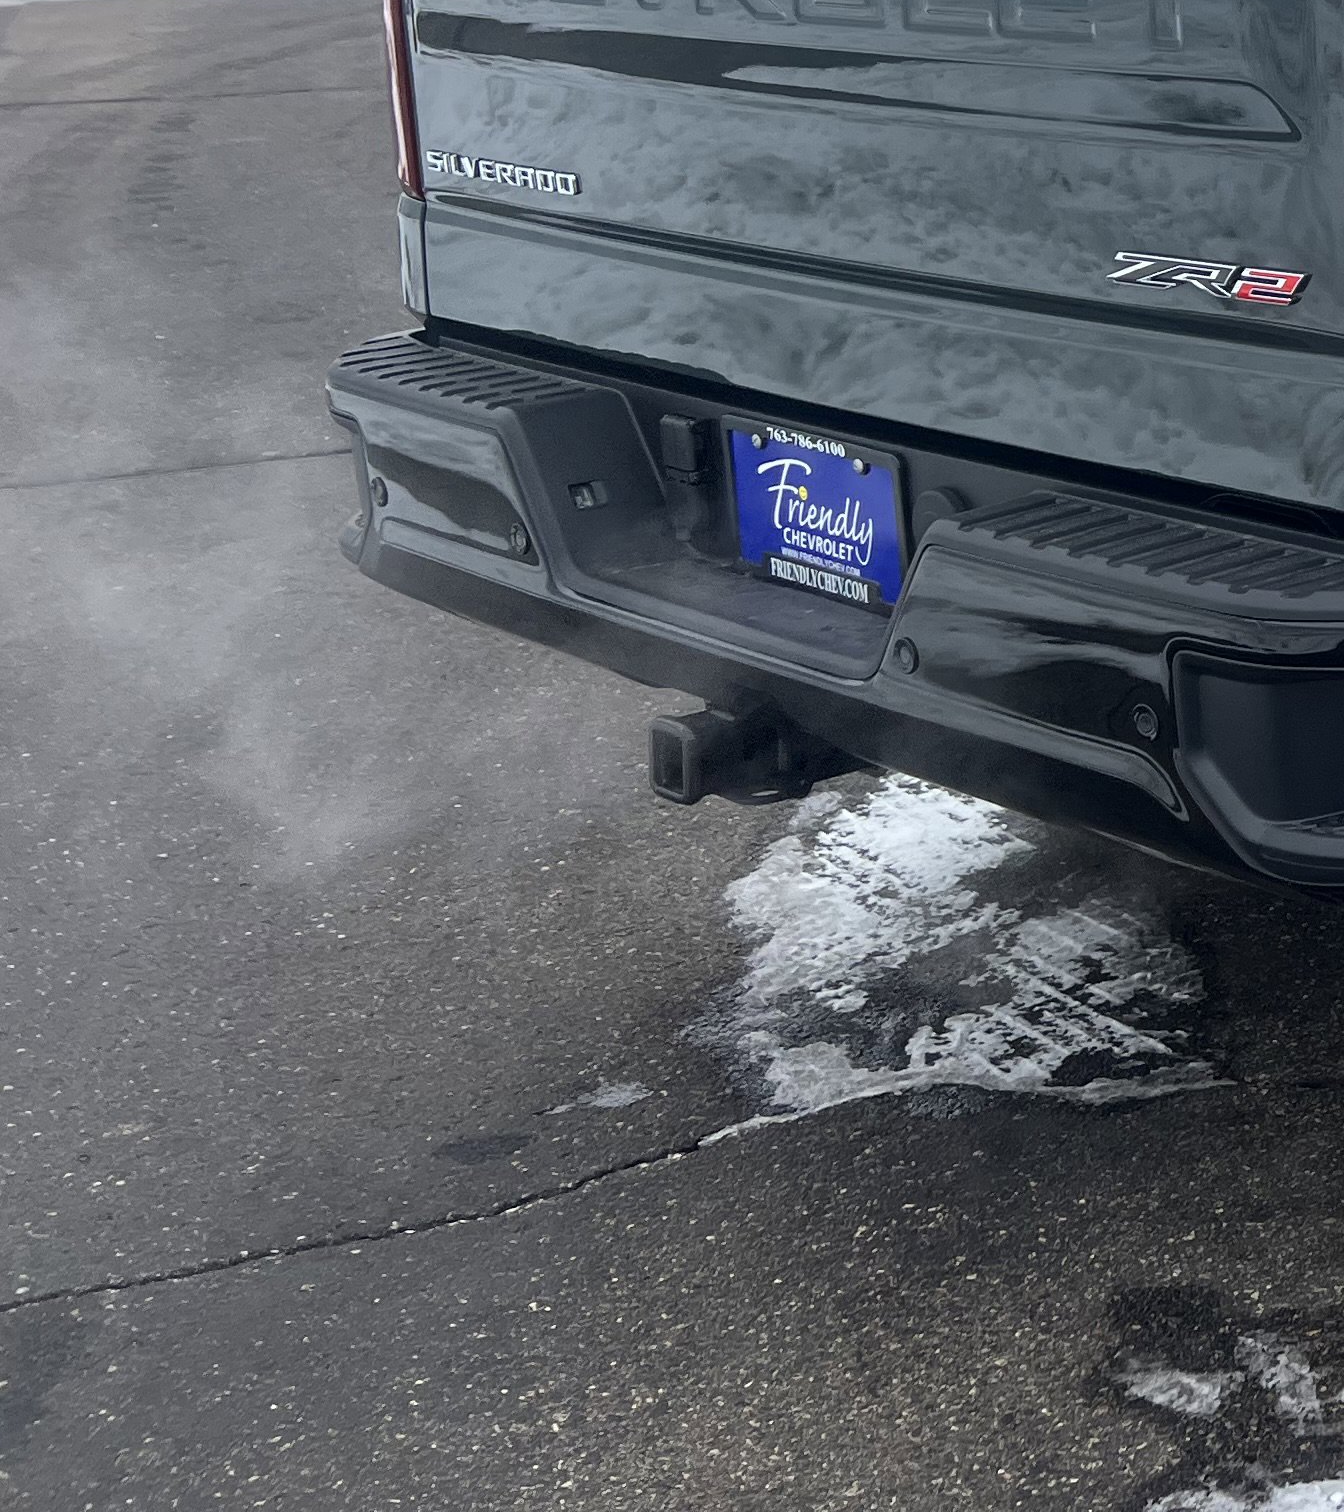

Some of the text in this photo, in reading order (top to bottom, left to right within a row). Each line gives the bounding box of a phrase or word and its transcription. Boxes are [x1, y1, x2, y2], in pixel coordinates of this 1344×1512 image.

[425, 149, 582, 196] SILVERADO
[1105, 250, 1310, 307] ZR2
[765, 426, 847, 458] 763-786-6100
[756, 457, 873, 566] Friendly
[782, 526, 854, 562] CHEVROLET
[769, 556, 870, 604] FRIENDLYCHEV.COM
